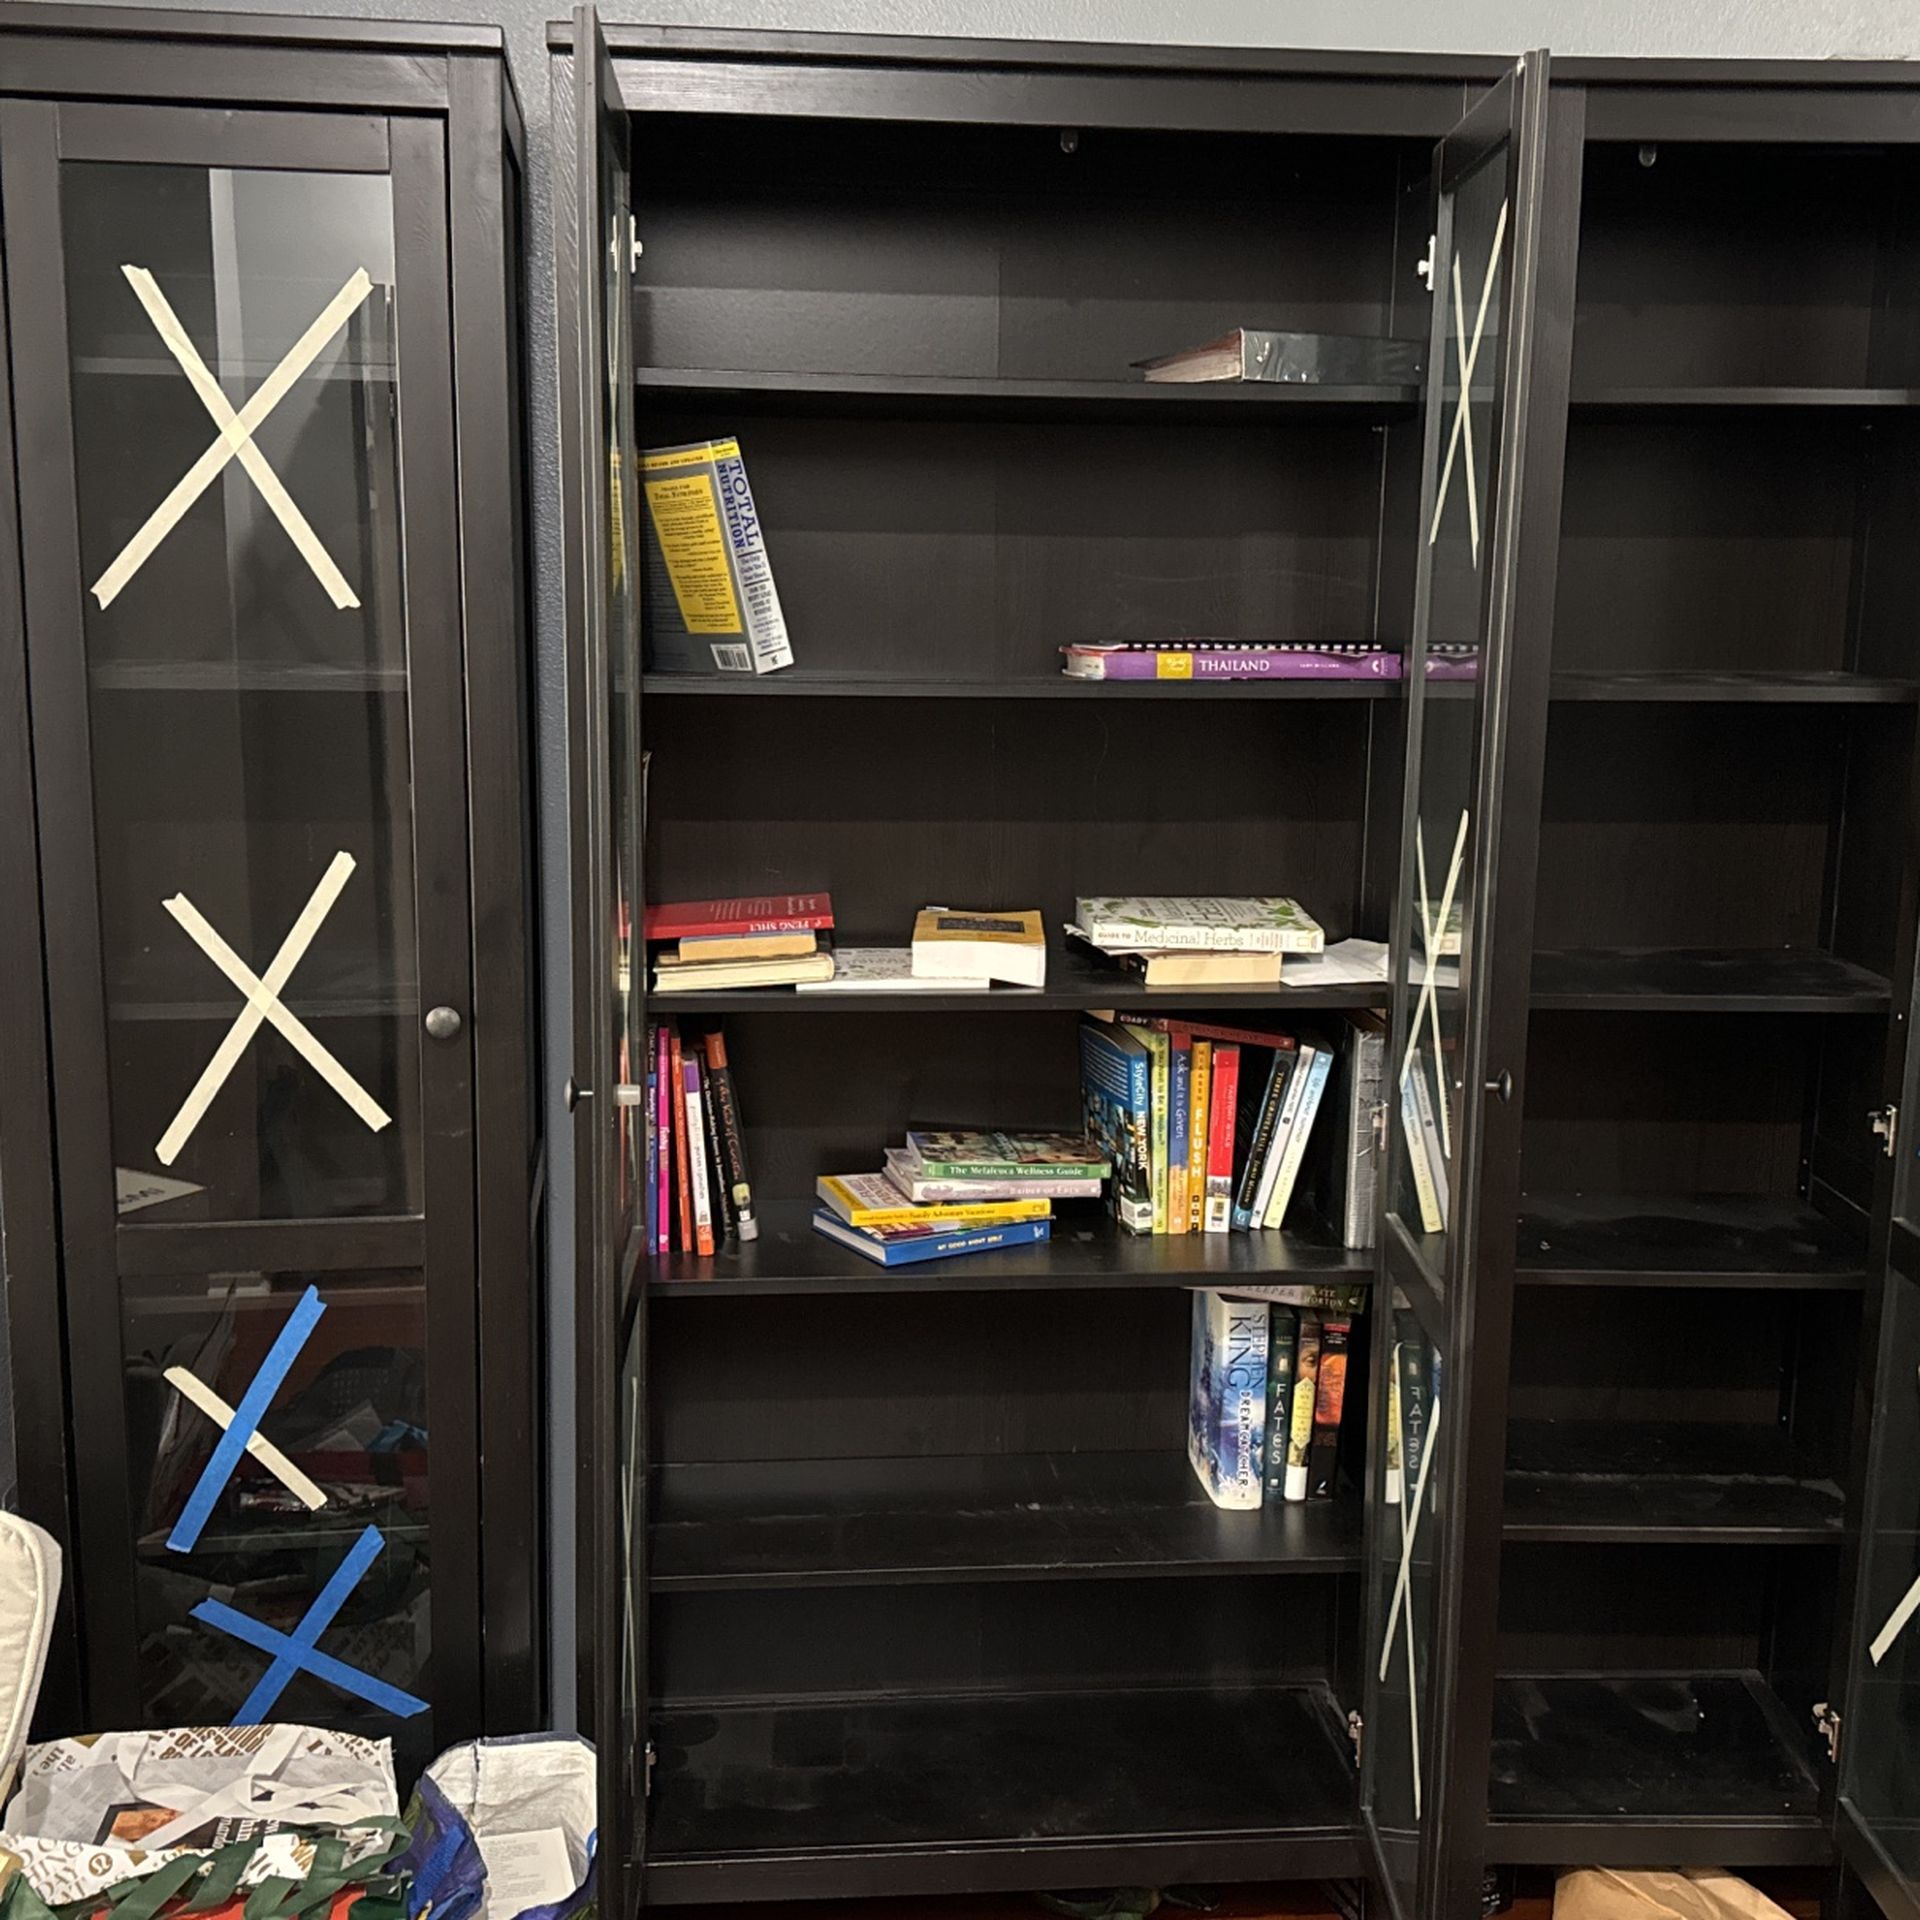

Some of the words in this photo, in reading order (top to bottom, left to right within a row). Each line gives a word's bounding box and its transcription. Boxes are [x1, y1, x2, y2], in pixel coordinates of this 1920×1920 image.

[717, 463, 746, 549] NUTRITION
[728, 460, 759, 546] TOTAL
[1199, 659, 1270, 672] THAILAND
[749, 921, 777, 932] SHUI
[779, 919, 809, 931] FENG
[1134, 930, 1199, 945] Medicinal
[1204, 932, 1244, 946] Herbs
[1176, 1052, 1189, 1073] Ask
[1134, 1061, 1146, 1106] StyleCity
[1176, 1076, 1185, 1090] and
[1136, 1110, 1146, 1135] NEW
[1175, 1108, 1186, 1138] Given
[1137, 1138, 1148, 1169] YORK
[1192, 1107, 1203, 1179] FLUSH
[950, 1166, 967, 1175] The
[971, 1166, 1015, 1176] Melaleuca
[1016, 1166, 1055, 1175] Wellness
[1056, 1166, 1084, 1176] Guide
[1227, 1315, 1251, 1389] KING
[1252, 1313, 1266, 1389] STEPHEN
[1239, 1390, 1251, 1487] DREAMCATCHER
[1271, 1383, 1286, 1464] FATES
[36, 1866, 79, 1898] DAY
